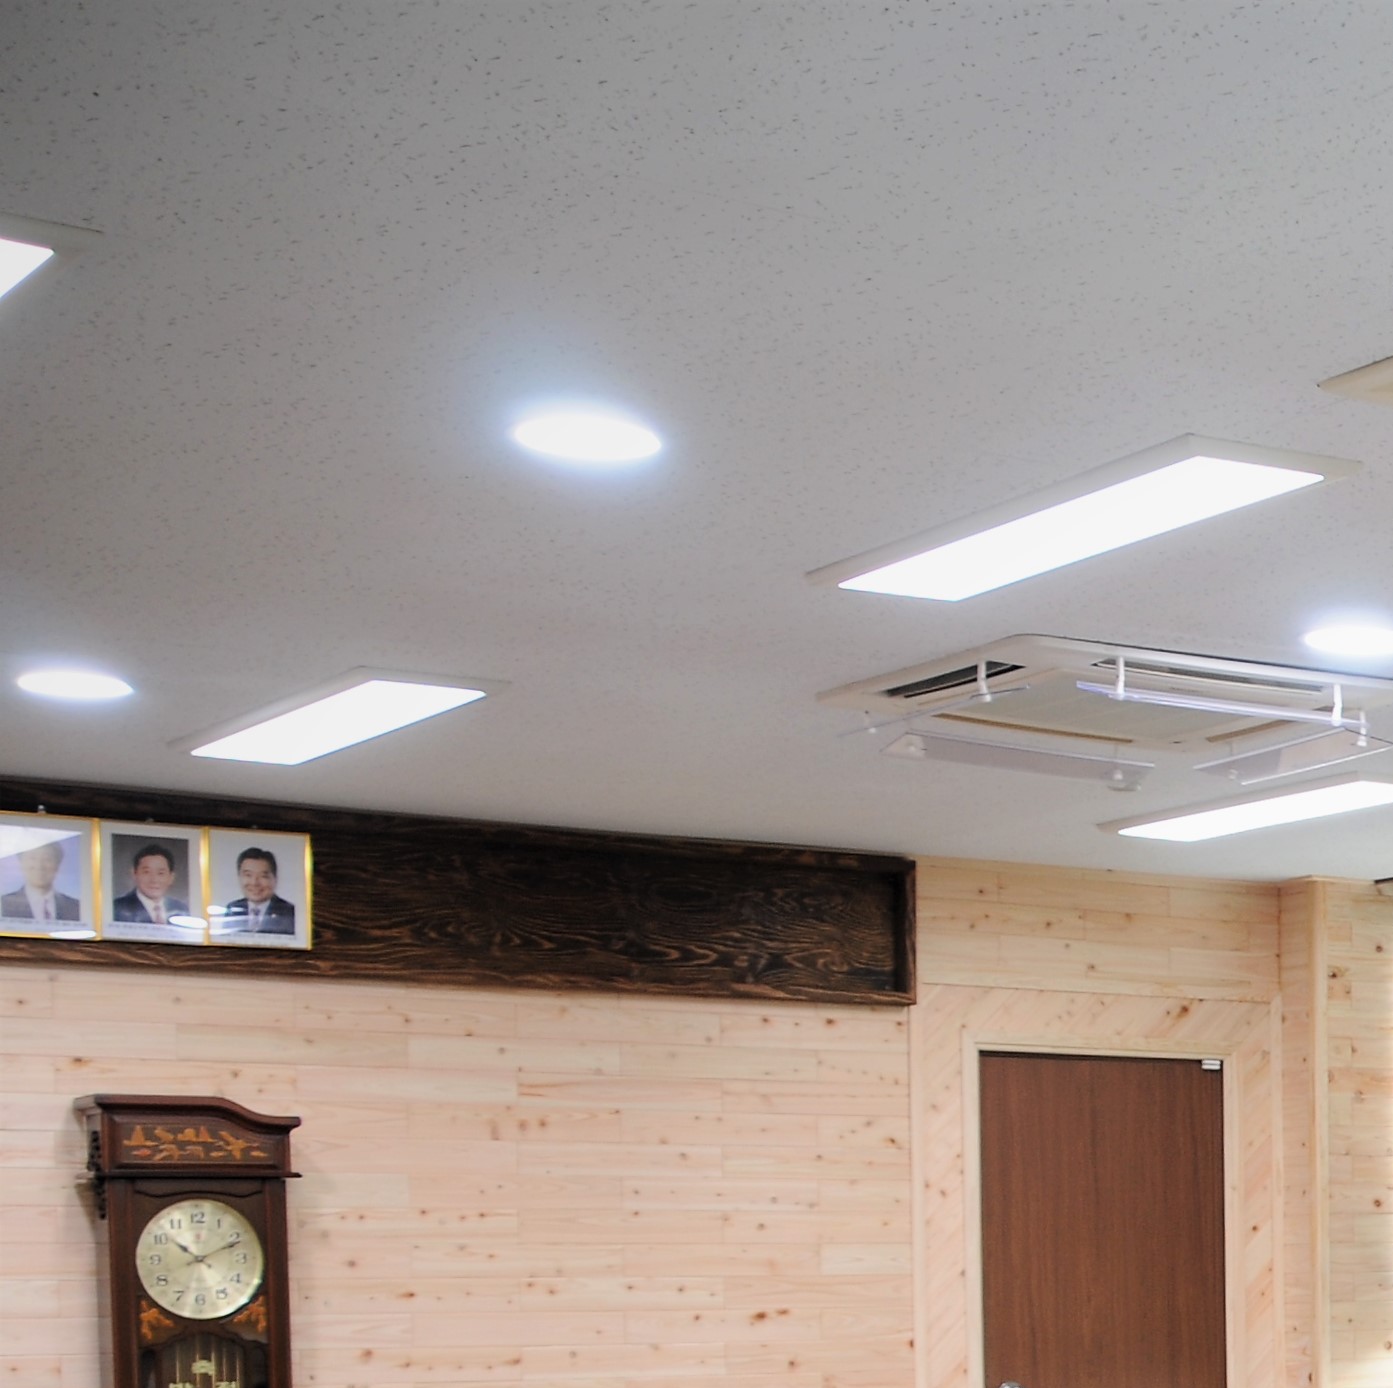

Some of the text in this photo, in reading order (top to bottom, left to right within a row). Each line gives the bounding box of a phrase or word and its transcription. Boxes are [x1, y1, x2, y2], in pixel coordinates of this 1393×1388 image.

[190, 1211, 205, 1224] 12
[170, 1219, 181, 1229] 11
[217, 1219, 221, 1228] 1
[154, 1233, 168, 1245] 10
[150, 1255, 160, 1265] 9
[236, 1253, 246, 1264] 3
[157, 1275, 168, 1286] 8
[231, 1274, 240, 1283] 4
[173, 1290, 184, 1301] 7
[195, 1294, 205, 1305] 6
[216, 1288, 227, 1300] 5
